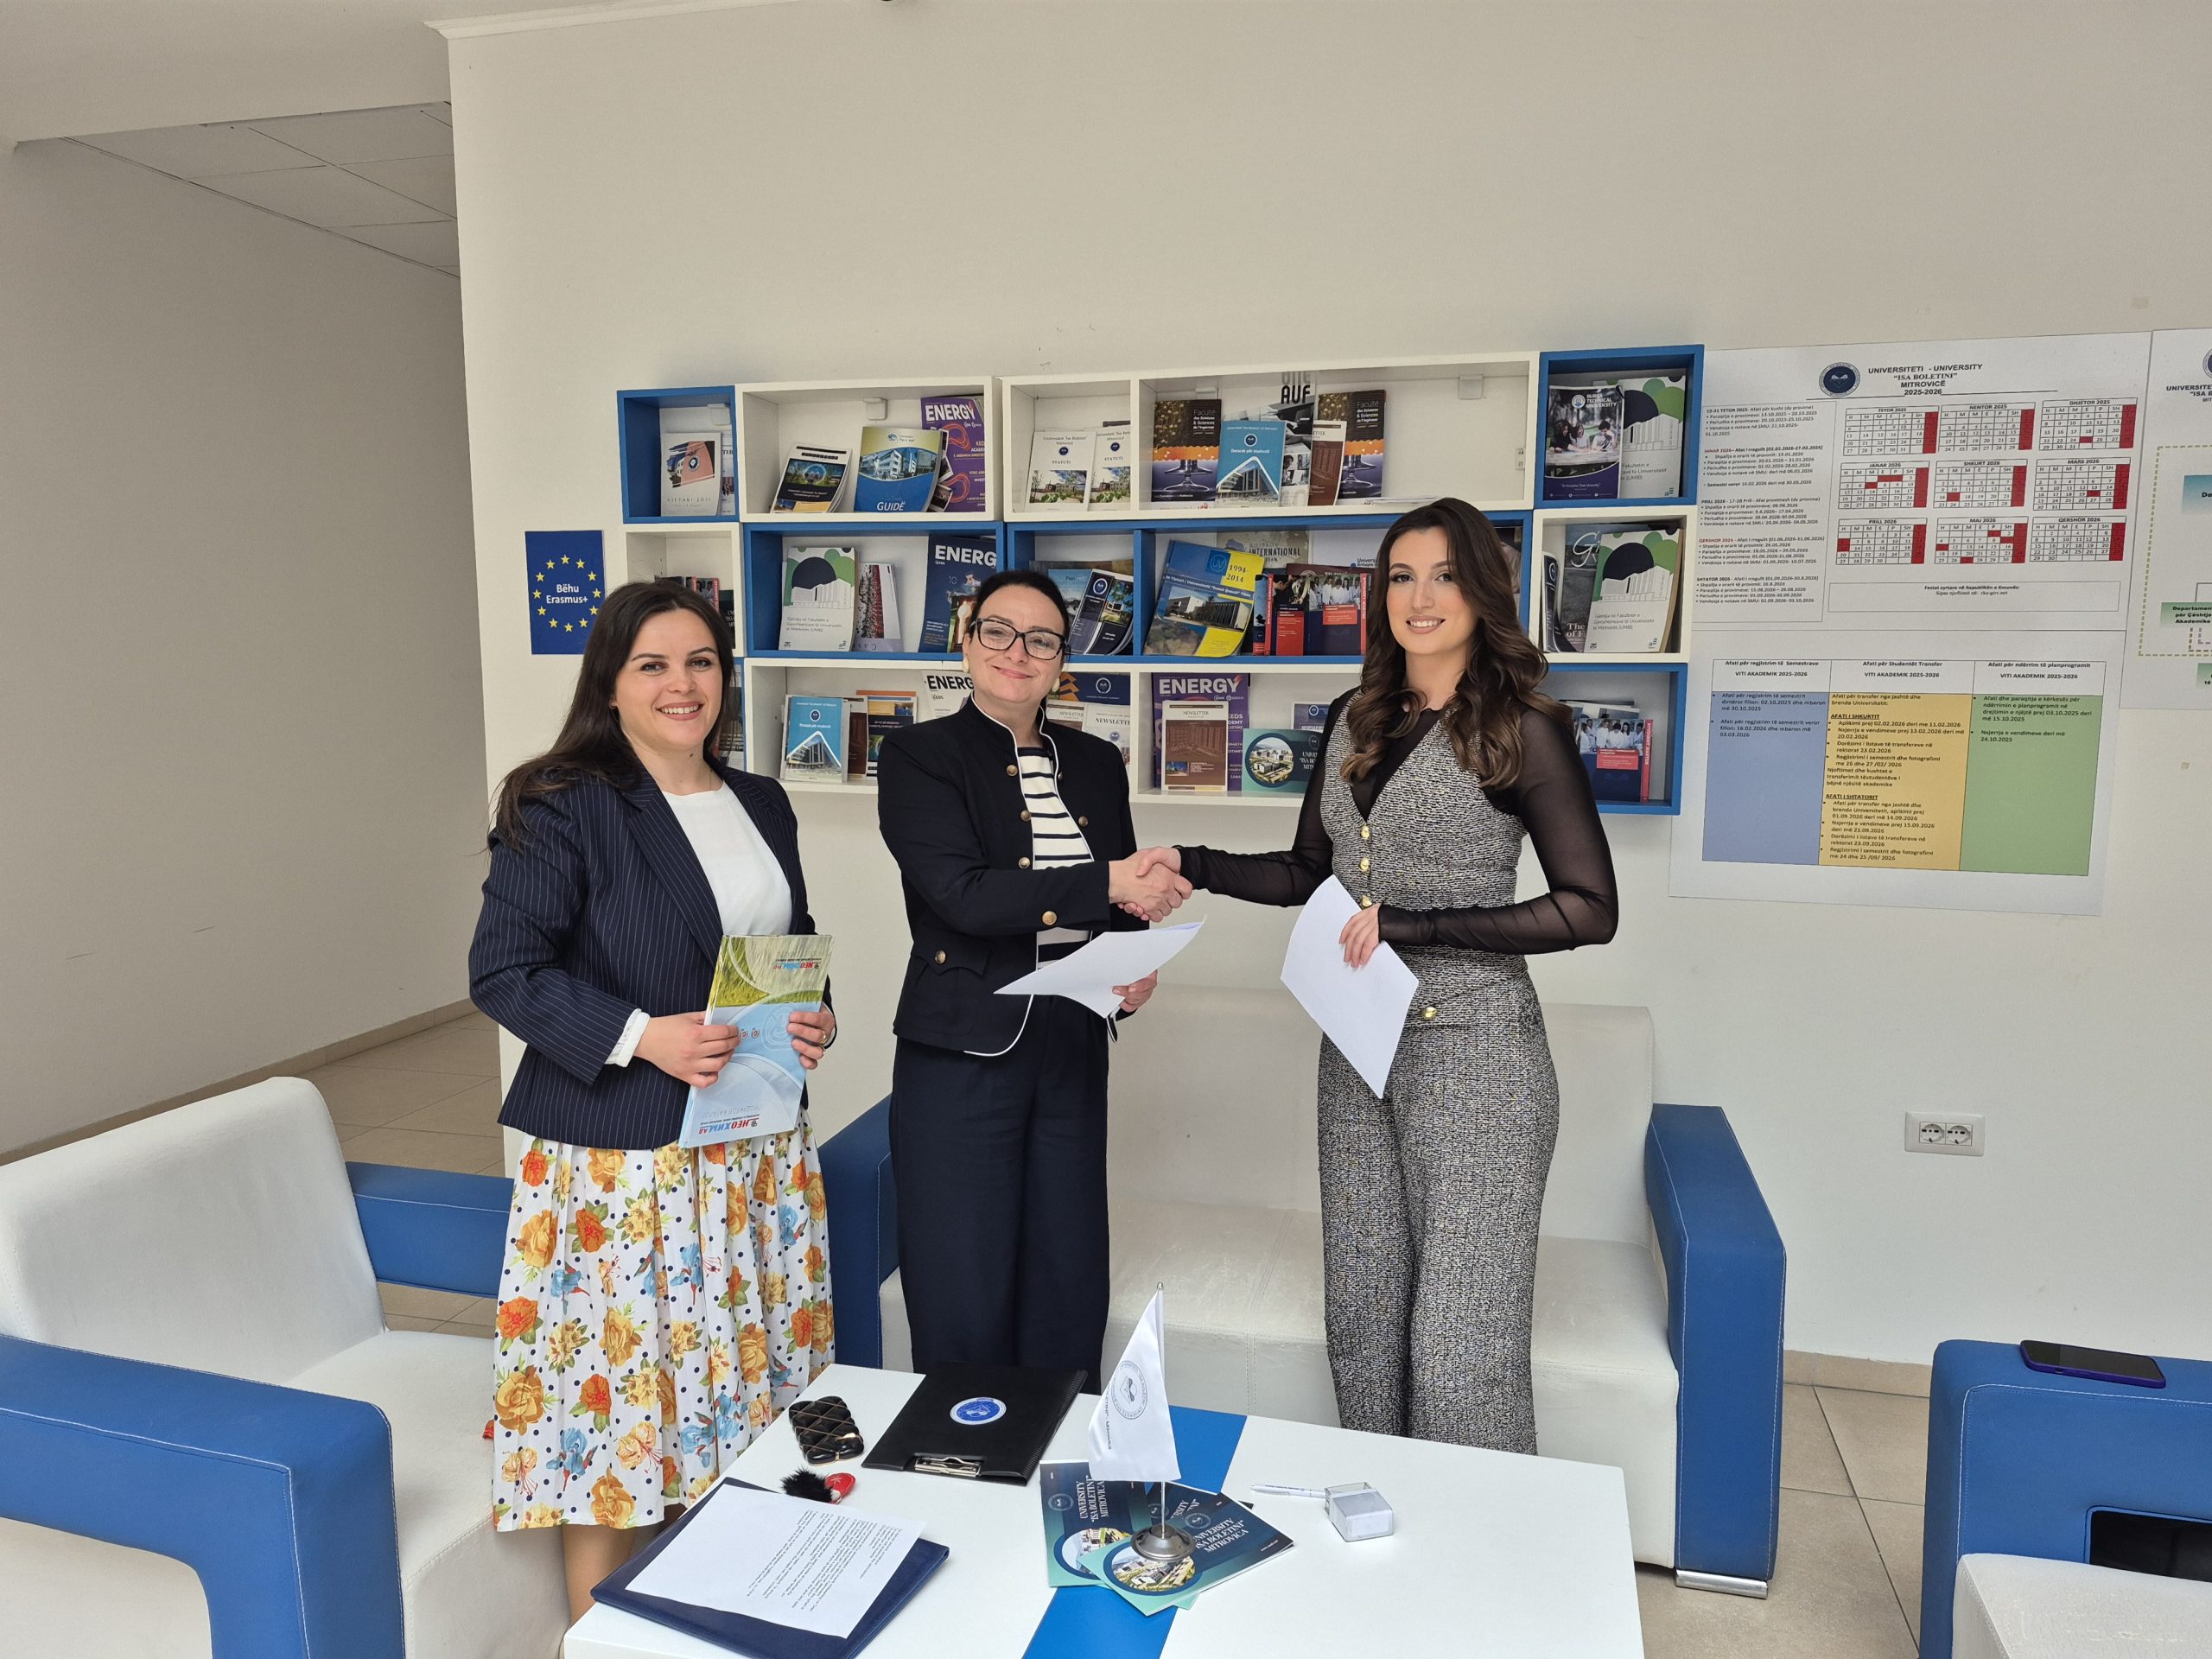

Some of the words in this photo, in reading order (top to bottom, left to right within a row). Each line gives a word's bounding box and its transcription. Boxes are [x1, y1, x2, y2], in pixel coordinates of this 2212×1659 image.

[1868, 365, 1923, 374] UNIVERSITETI
[1281, 384, 1310, 404] AUF
[925, 404, 976, 422] ENERGY
[935, 545, 997, 567] ENERG
[1249, 547, 1300, 556] INTERNATIONAL
[1230, 564, 1248, 573] 1994-
[1227, 573, 1244, 583] 2014
[556, 584, 579, 593] Bëhu
[546, 595, 588, 604] Erasmus+
[926, 675, 974, 690] ENERG
[1159, 678, 1240, 694] ENERGY
[1095, 718, 1130, 726] NEWSLETTE
[709, 1119, 750, 1133] НЕОХИМ
[1076, 1480, 1088, 1519] UNIVERSITY
[1096, 1481, 1109, 1517] MITROVICA
[1196, 1538, 1210, 1550] ISA
[1204, 1529, 1249, 1553] MITROVICA
